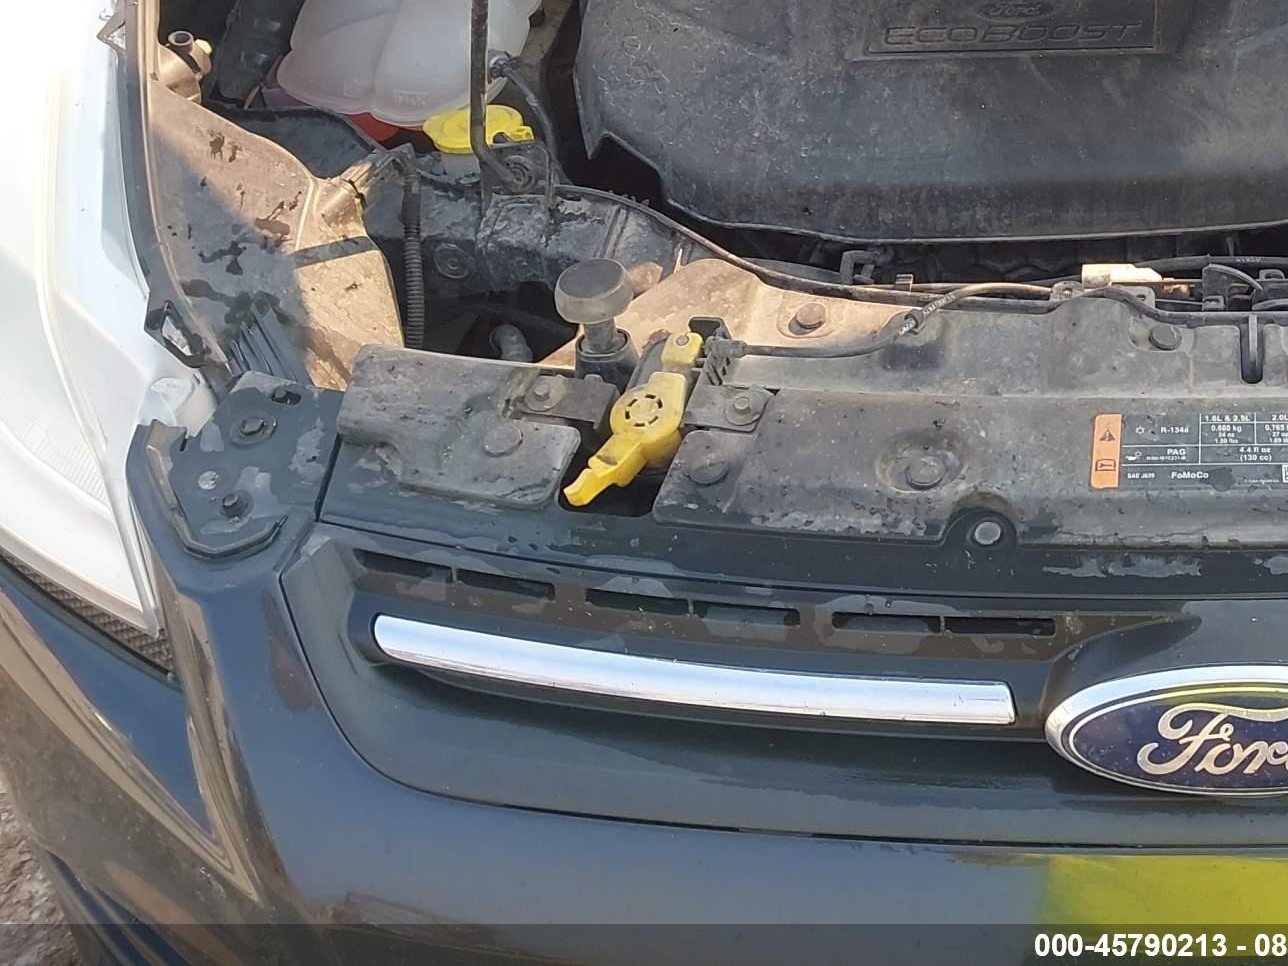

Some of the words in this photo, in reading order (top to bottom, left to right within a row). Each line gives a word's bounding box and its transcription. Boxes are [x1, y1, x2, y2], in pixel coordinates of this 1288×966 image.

[884, 22, 1142, 45] ECOBOOST
[1160, 426, 1189, 434] R-134a
[1232, 424, 1242, 433] kg
[1171, 471, 1209, 479] FoMoCo
